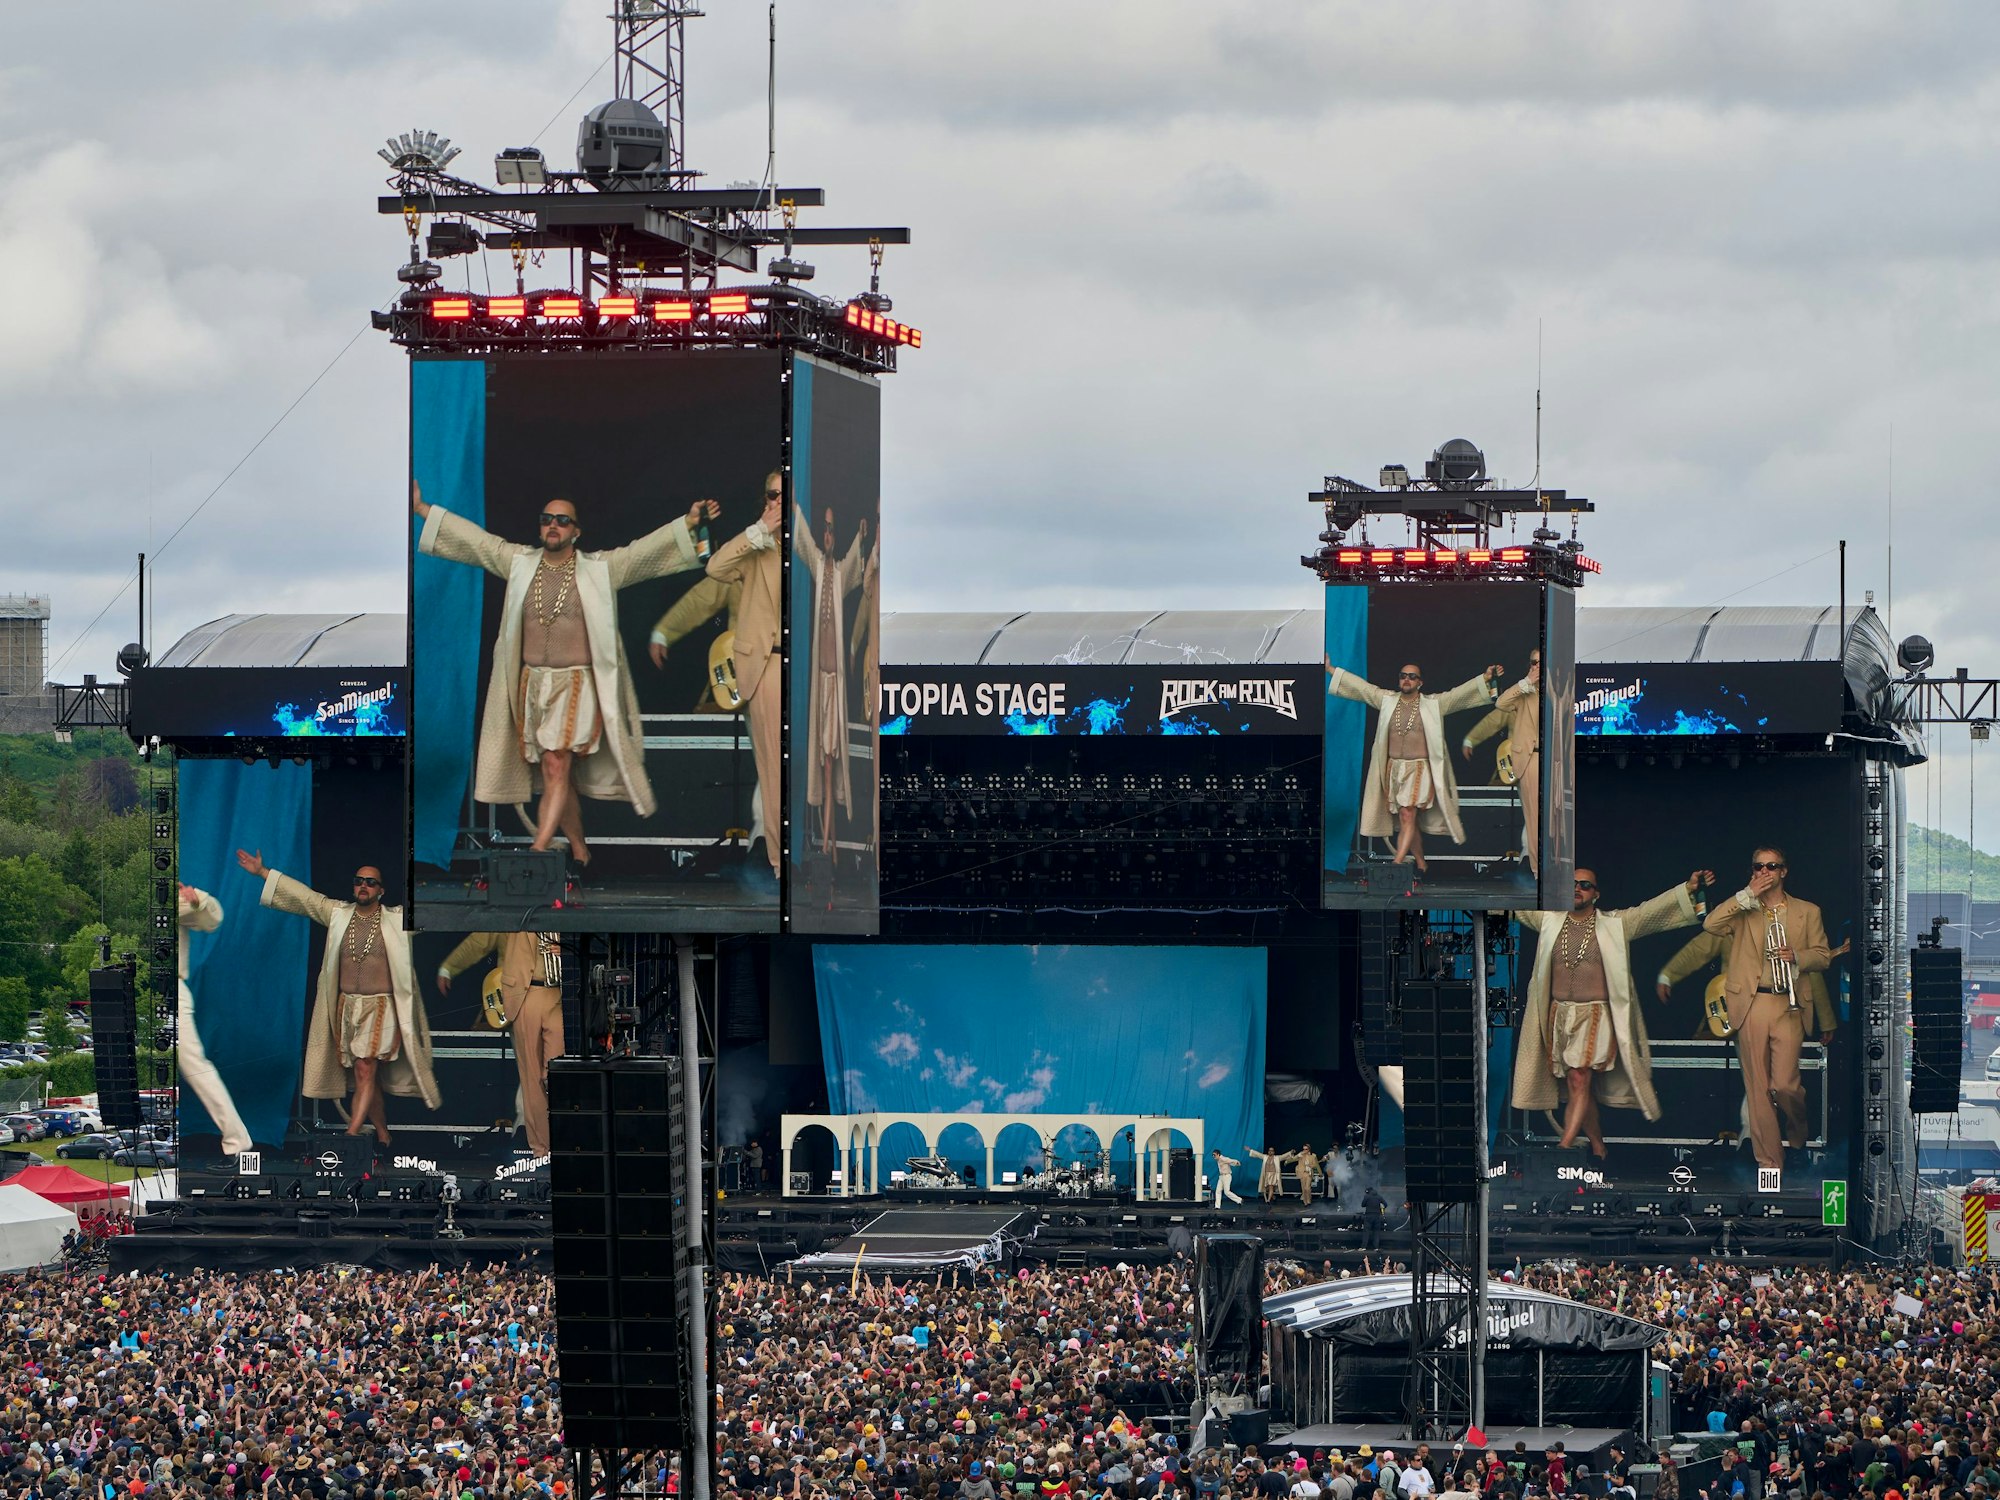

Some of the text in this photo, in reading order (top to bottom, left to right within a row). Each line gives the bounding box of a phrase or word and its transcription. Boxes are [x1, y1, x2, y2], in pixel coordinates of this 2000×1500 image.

[879, 683, 1066, 716] TOPIA STAGE
[1159, 680, 1297, 720] ROCK AM RING
[1574, 678, 1641, 715] anMiguel
[242, 1154, 258, 1171] Bild
[393, 1155, 437, 1171] SIMON
[1557, 1166, 1604, 1184] SIMON
[1760, 1171, 1778, 1189] Bild
